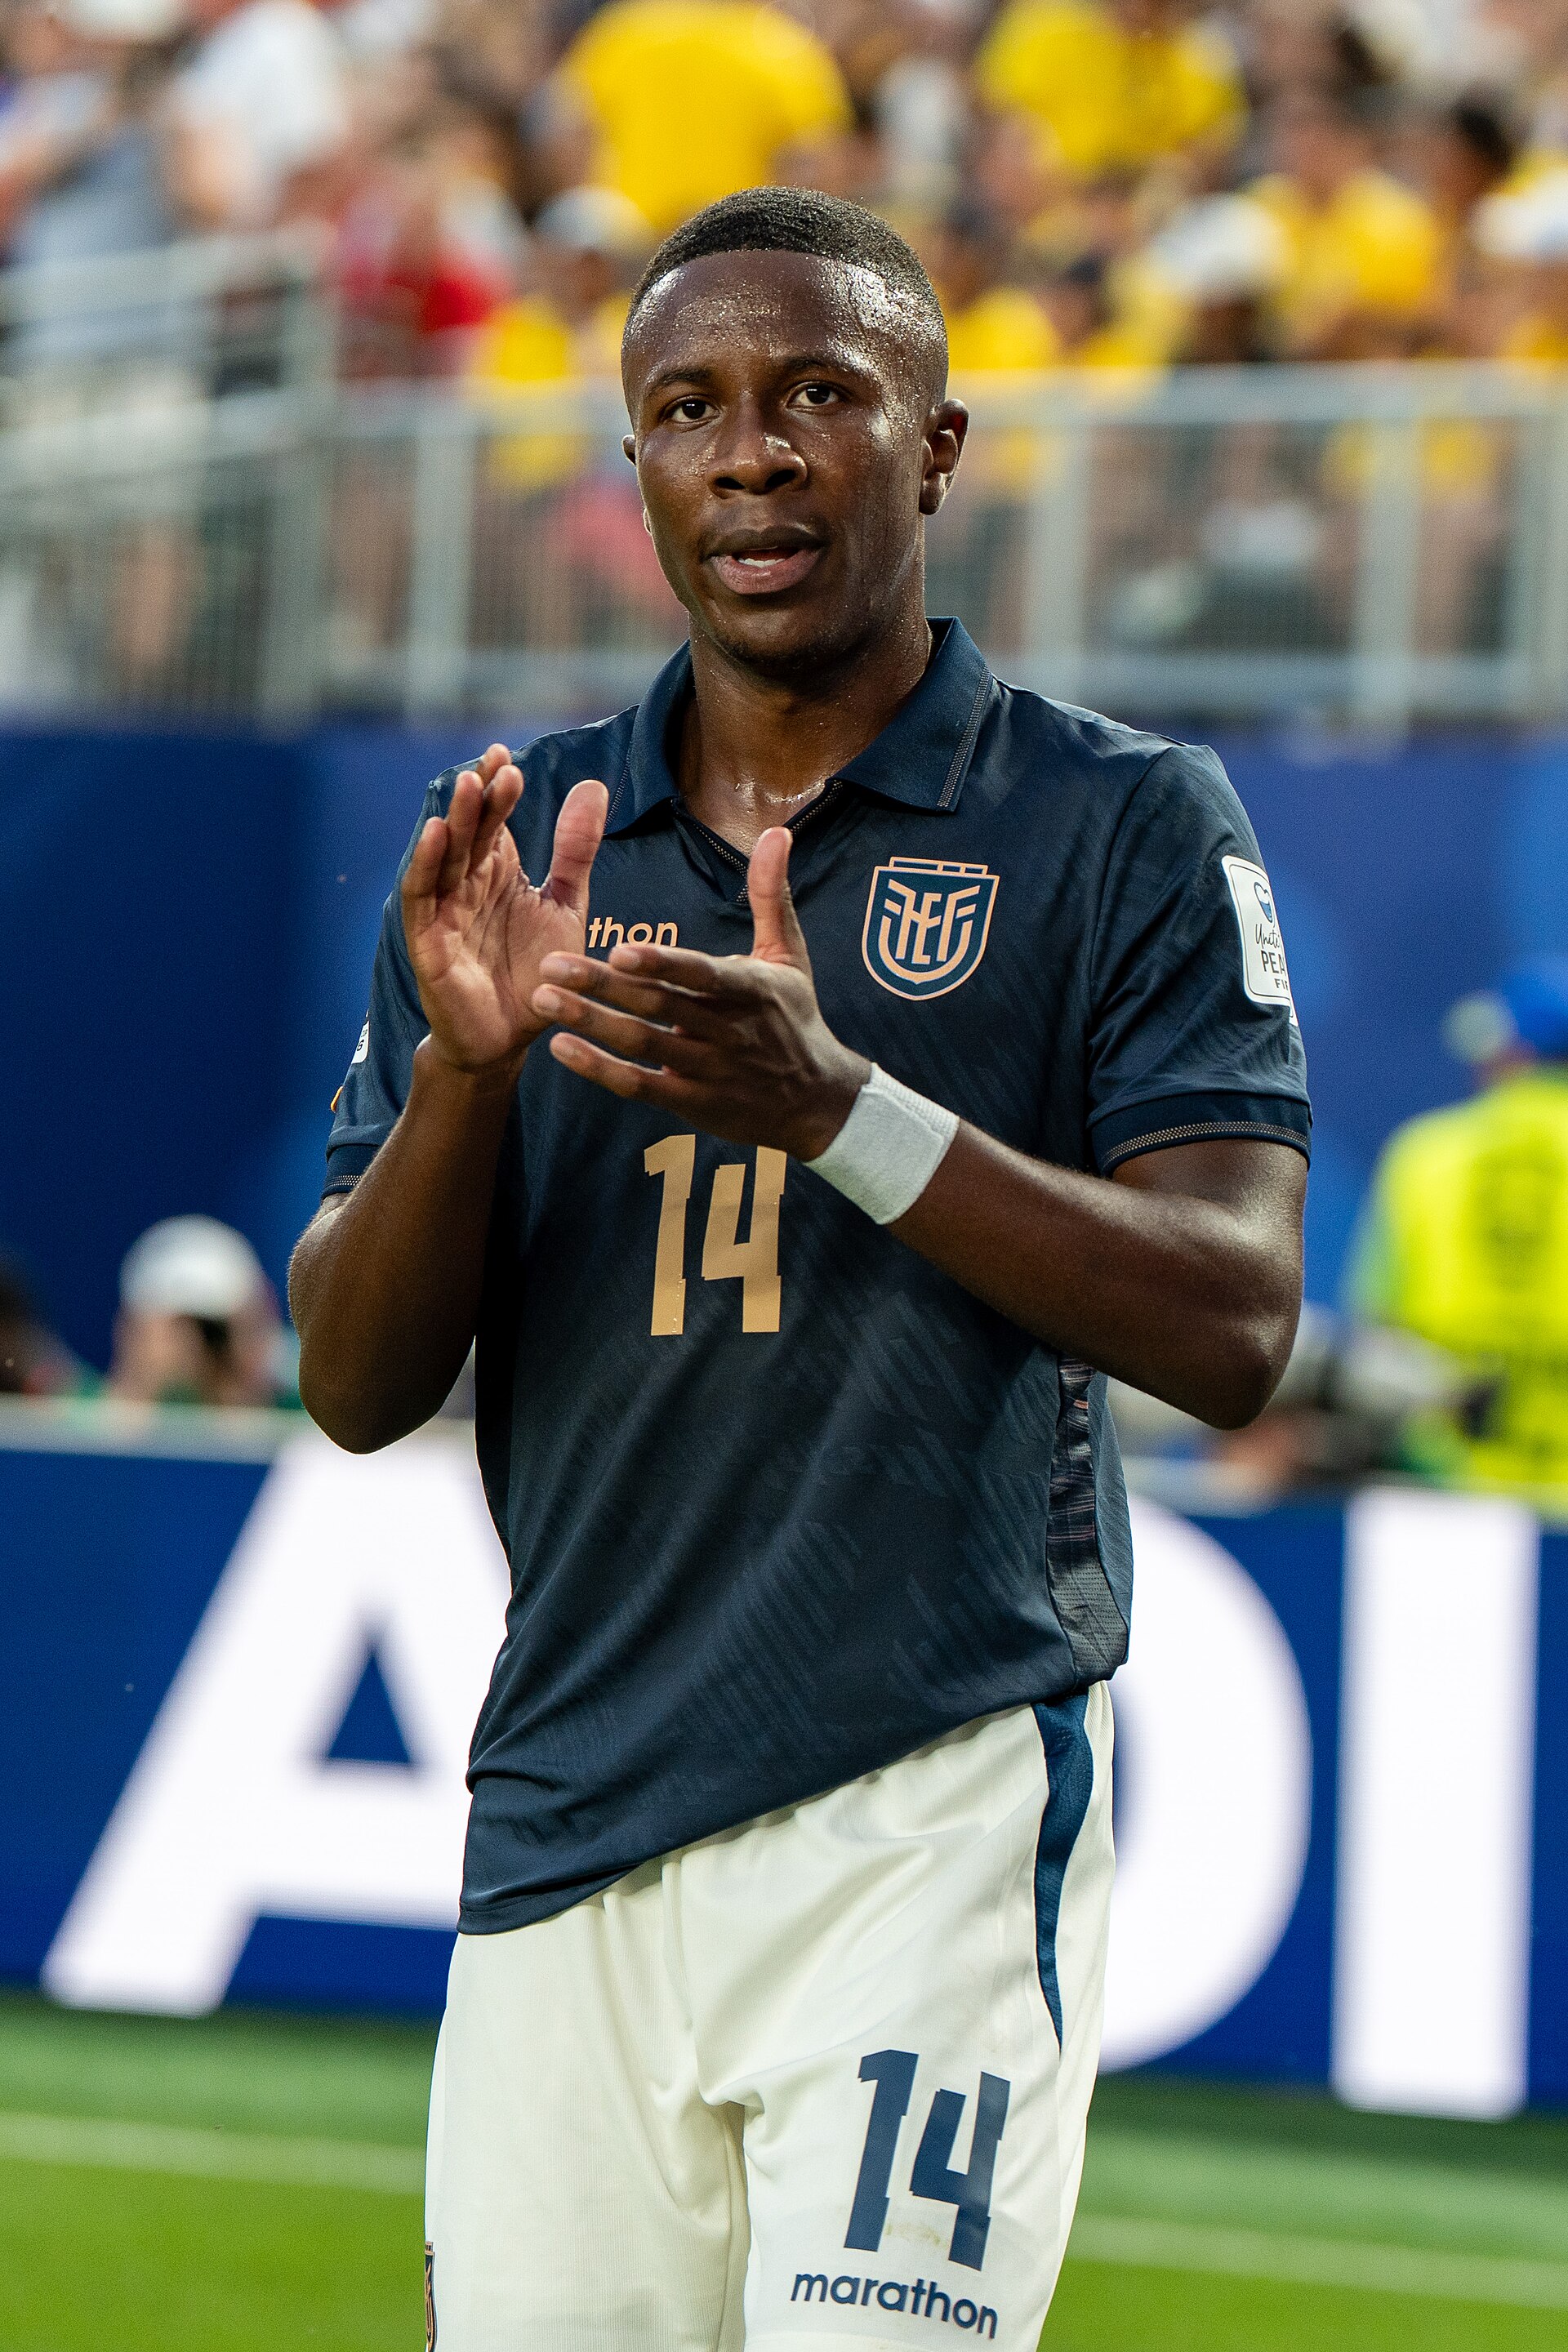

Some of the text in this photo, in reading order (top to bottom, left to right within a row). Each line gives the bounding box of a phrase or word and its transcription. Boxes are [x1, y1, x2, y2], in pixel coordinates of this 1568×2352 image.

[588, 916, 679, 948] thon
[644, 1134, 787, 1336] 14
[844, 2049, 1011, 2272] 14
[790, 2273, 999, 2340] marathon
